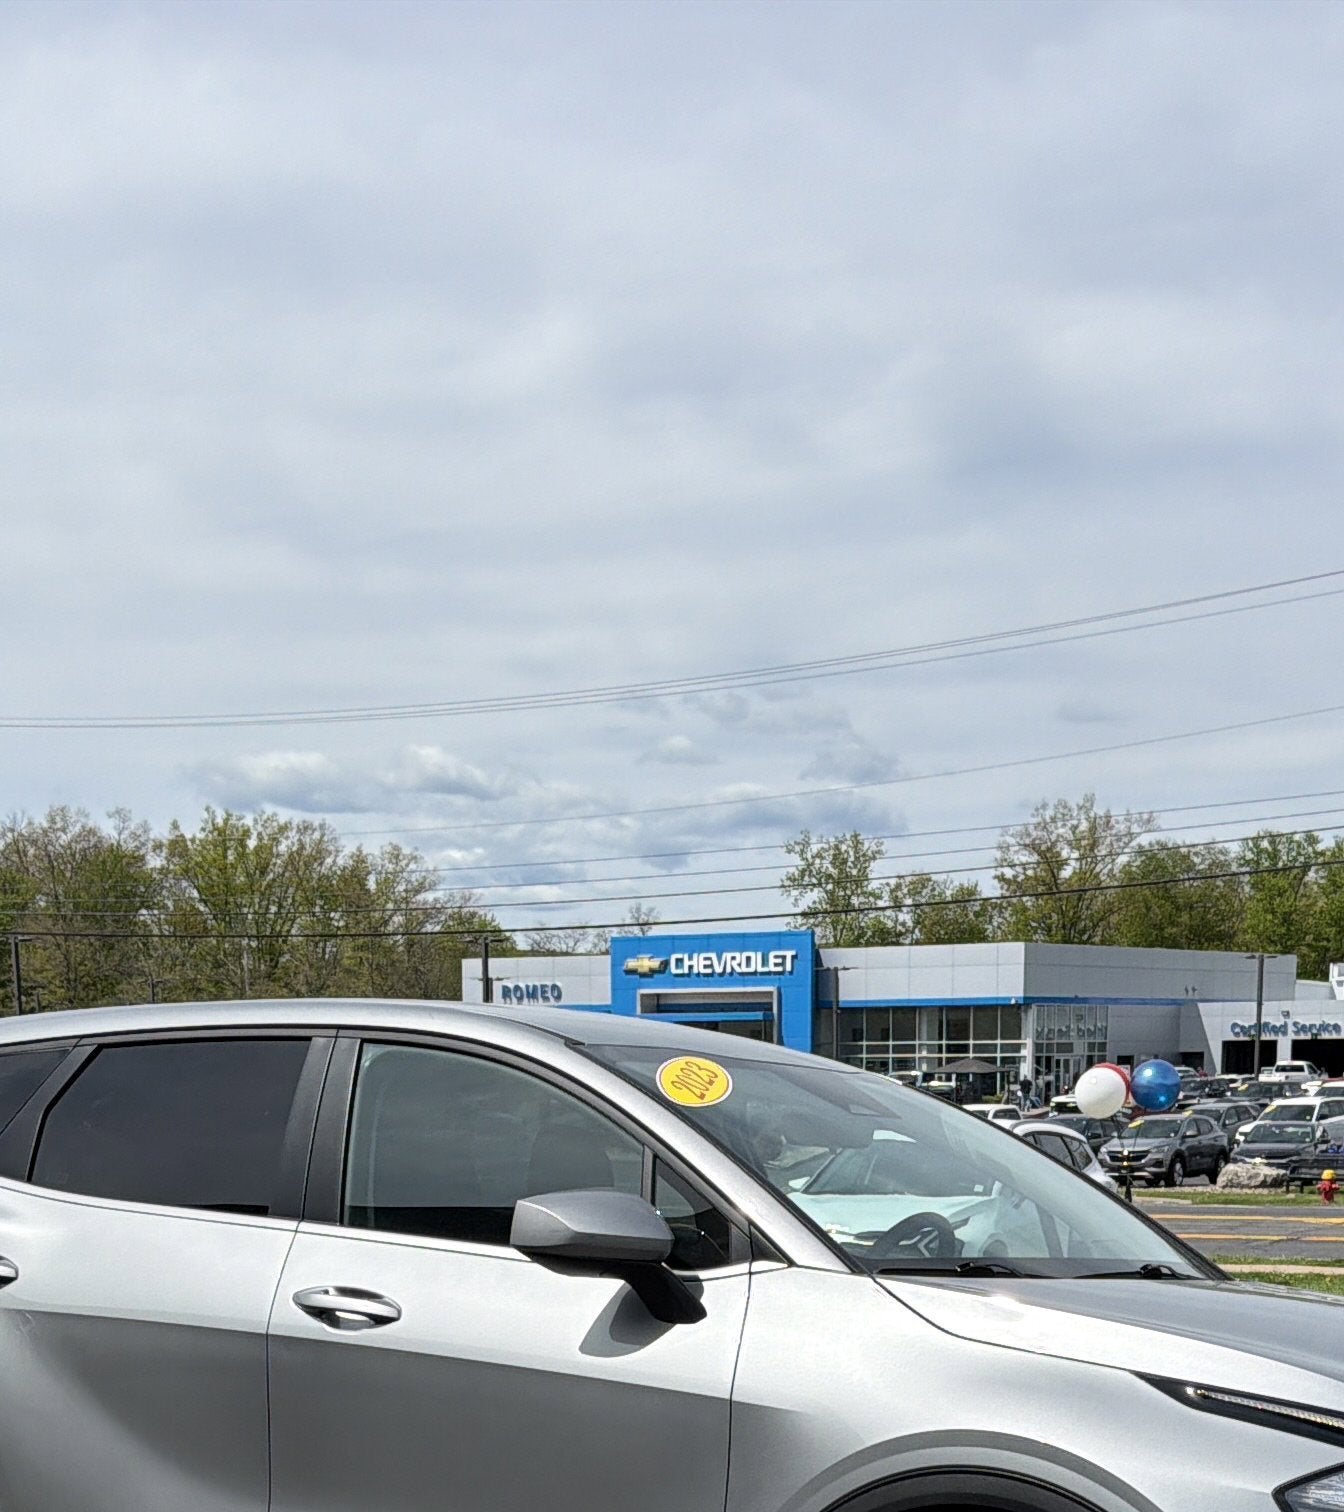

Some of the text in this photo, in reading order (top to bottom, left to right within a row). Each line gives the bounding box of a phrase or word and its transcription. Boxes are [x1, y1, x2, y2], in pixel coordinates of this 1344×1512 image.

[669, 950, 797, 975] CHEVROLET
[501, 983, 562, 1004] ROMEO
[1230, 1020, 1342, 1037] Certfied Service
[670, 1060, 719, 1100] 2023
